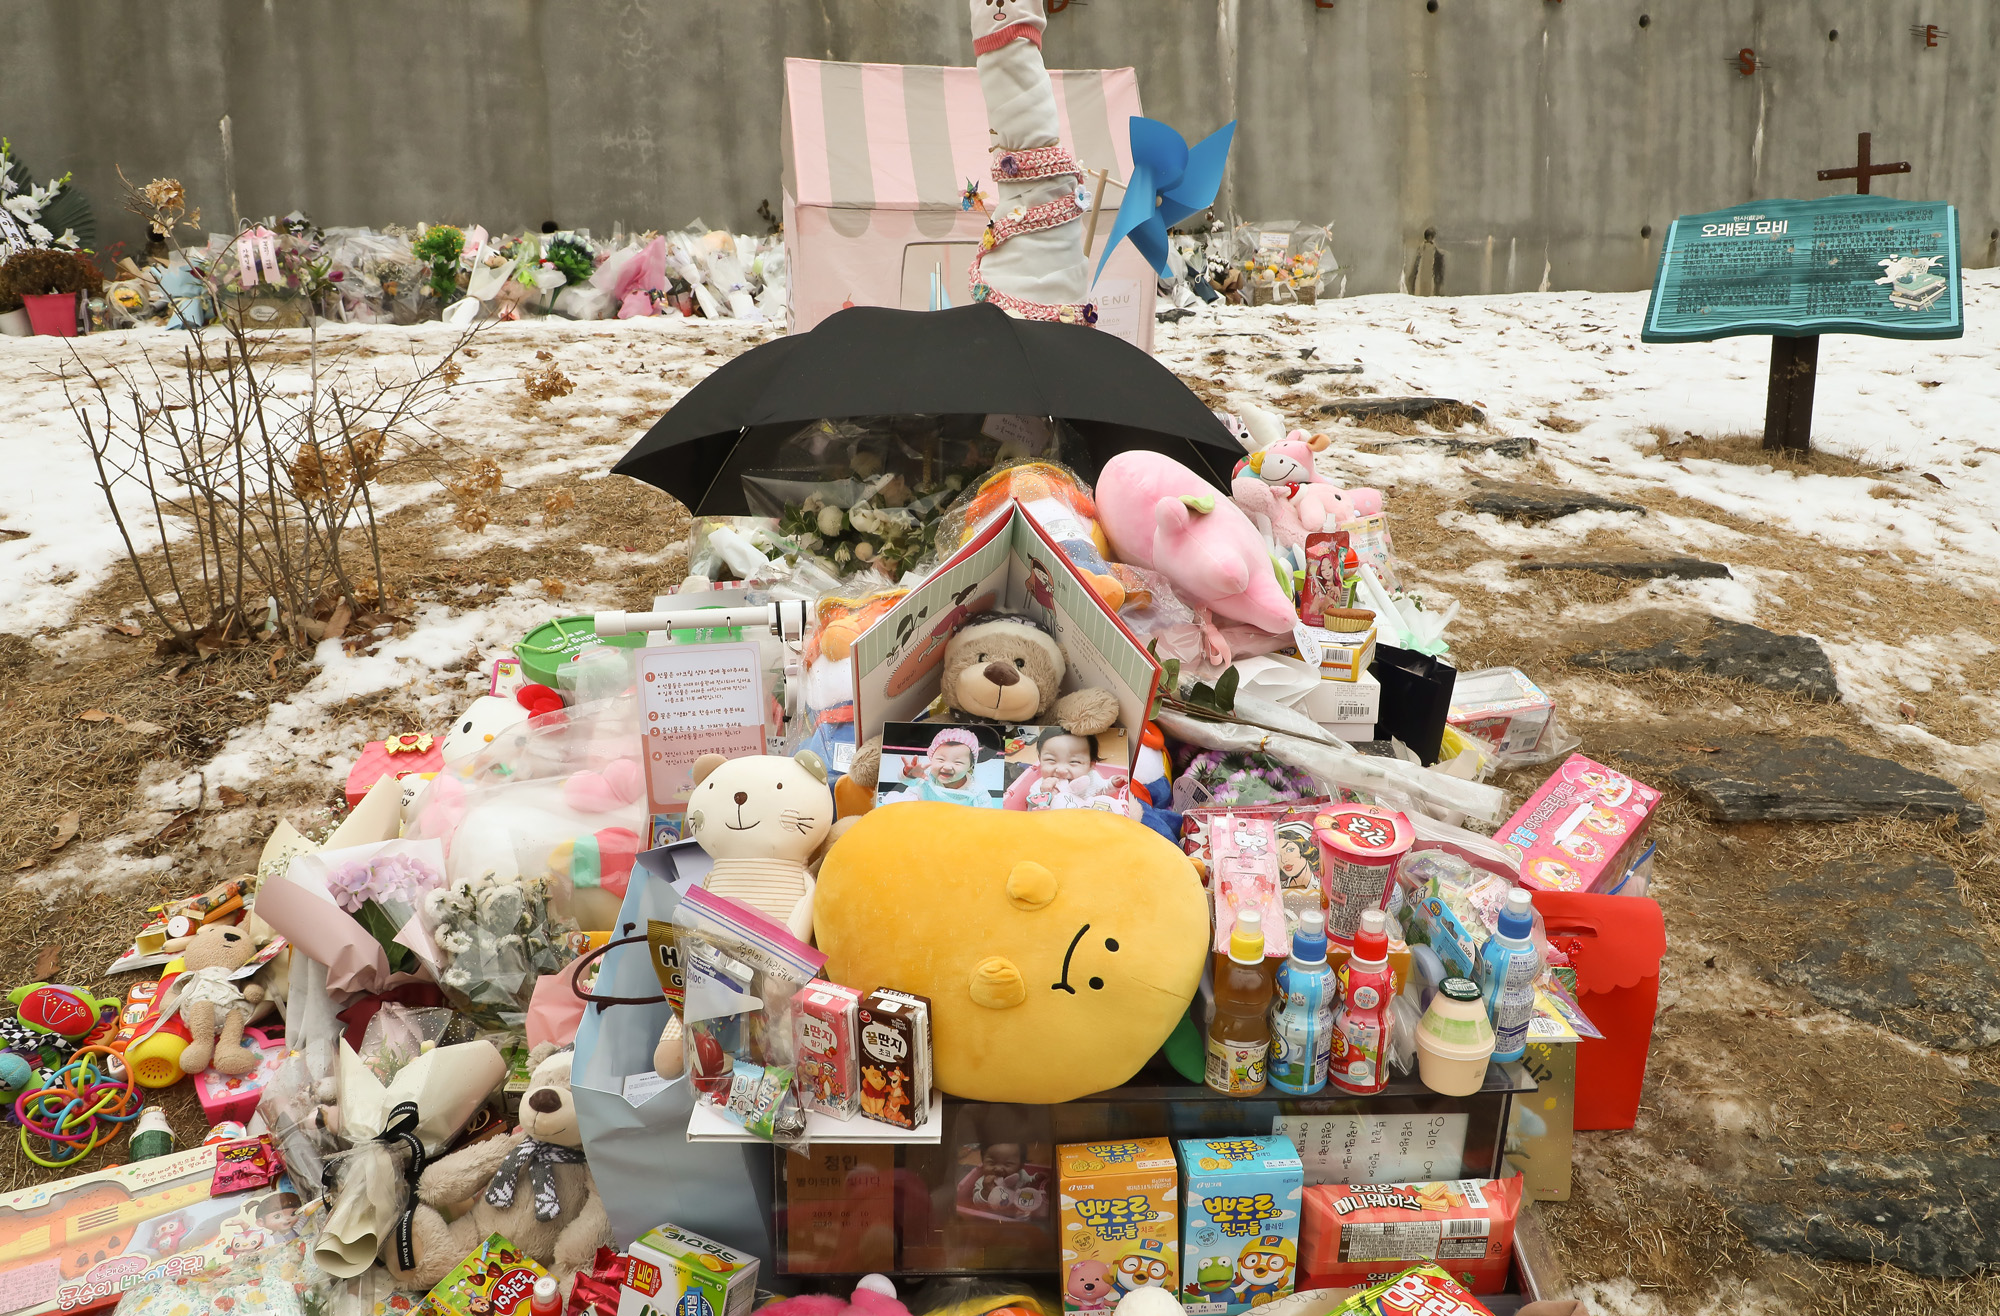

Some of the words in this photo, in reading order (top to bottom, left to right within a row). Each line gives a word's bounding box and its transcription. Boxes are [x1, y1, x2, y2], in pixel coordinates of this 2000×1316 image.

[1701, 222, 1751, 237] 오래된
[1754, 220, 1788, 235] 묘비
[1088, 295, 1130, 306] MENU
[1347, 816, 1389, 847] 칸쵸
[810, 1040, 823, 1050] 딸기
[865, 1031, 903, 1053] 꿀딴지
[878, 1048, 891, 1058] 초코
[824, 1154, 858, 1171] 정인
[1349, 1184, 1394, 1194] 오리온
[1075, 1195, 1159, 1226] 뽀로로와
[1203, 1194, 1283, 1222] 뽀로로와
[1332, 1192, 1423, 1216] 미니웨하스
[401, 1209, 411, 1242] BENJAMIN
[1096, 1223, 1138, 1240] 친구들
[1221, 1220, 1262, 1236] 친구들
[1264, 1222, 1284, 1231] 플레인
[664, 1230, 738, 1264] 카스타드
[94, 1262, 139, 1281] 노래하는
[626, 1259, 637, 1287] 대한민국
[633, 1263, 654, 1292] 1등
[57, 1280, 112, 1311] 콩순이
[493, 1270, 536, 1311] 초코송이
